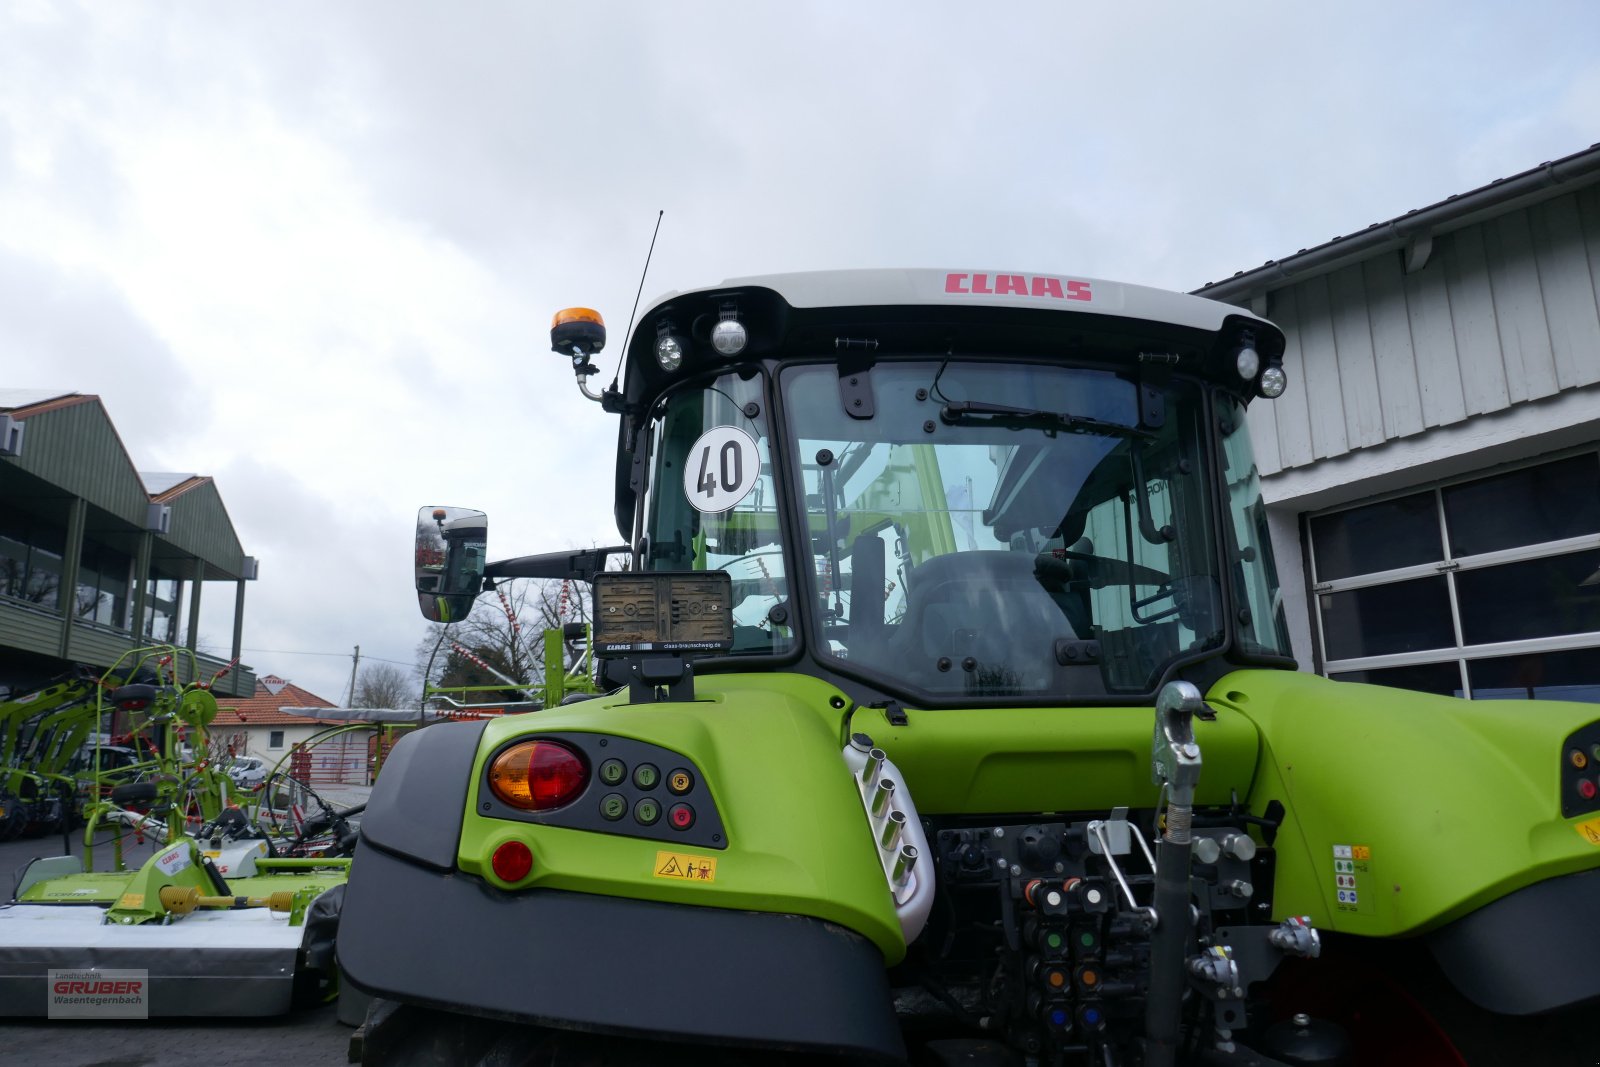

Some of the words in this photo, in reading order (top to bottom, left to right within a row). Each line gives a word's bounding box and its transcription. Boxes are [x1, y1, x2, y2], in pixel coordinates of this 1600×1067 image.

[945, 273, 1091, 302] CLAAS
[697, 440, 744, 499] 40
[664, 642, 721, 650] claas-braunschweig.de
[161, 851, 180, 865] CLAAS
